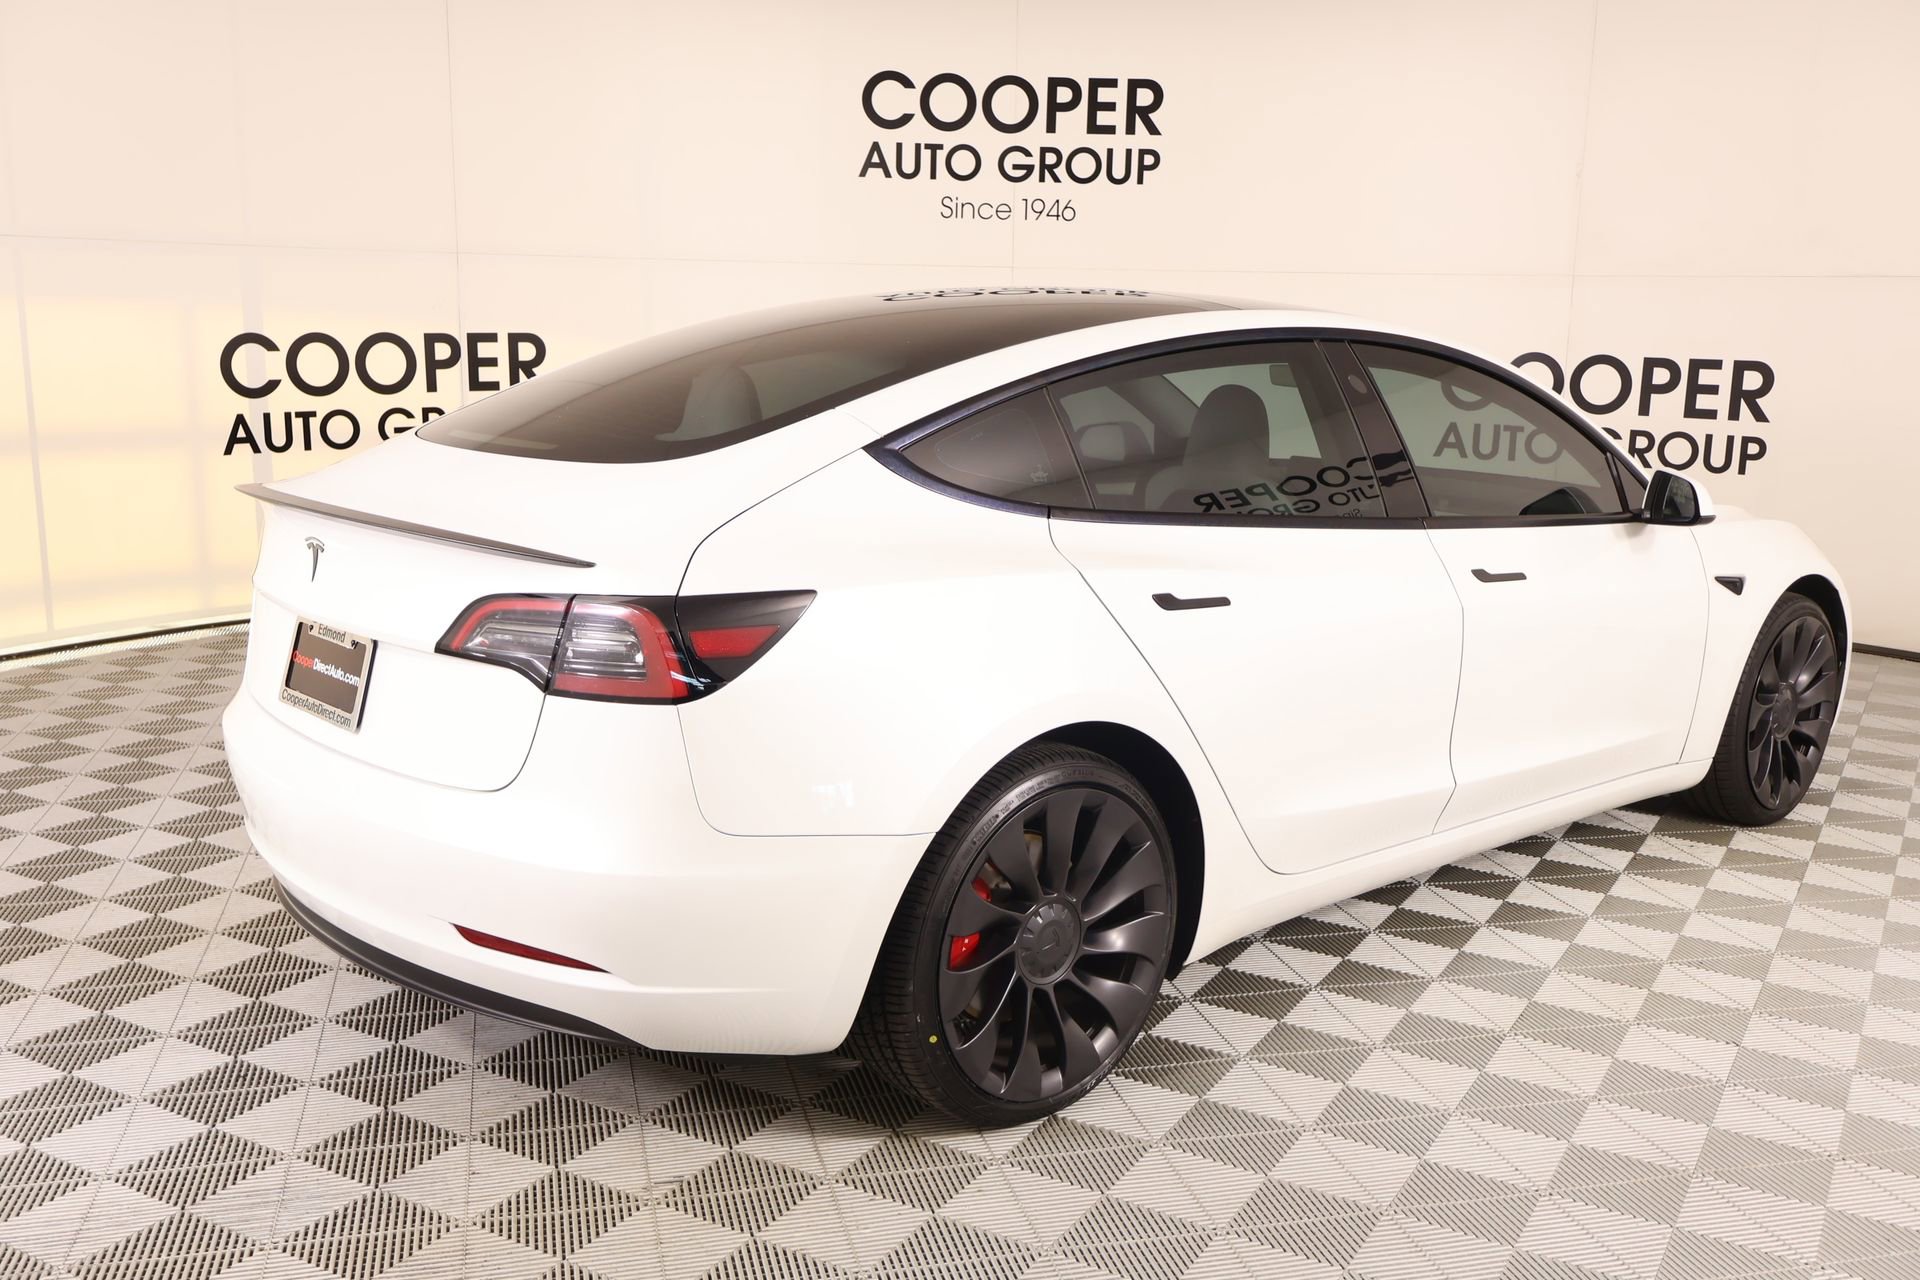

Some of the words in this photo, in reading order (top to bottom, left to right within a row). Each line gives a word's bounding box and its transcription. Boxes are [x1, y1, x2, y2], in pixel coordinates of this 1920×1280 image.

[861, 70, 1164, 136] COOPER
[858, 141, 982, 182] AUTO
[998, 145, 1161, 185] GROUP
[940, 196, 1012, 220] Since
[1021, 198, 1077, 222] 1946
[220, 332, 547, 399] COOPER
[223, 409, 361, 456] AUTO
[1433, 421, 1562, 465] AUTO
[317, 623, 347, 643] Edmond
[282, 688, 352, 728] CooperAutoDirect.com
